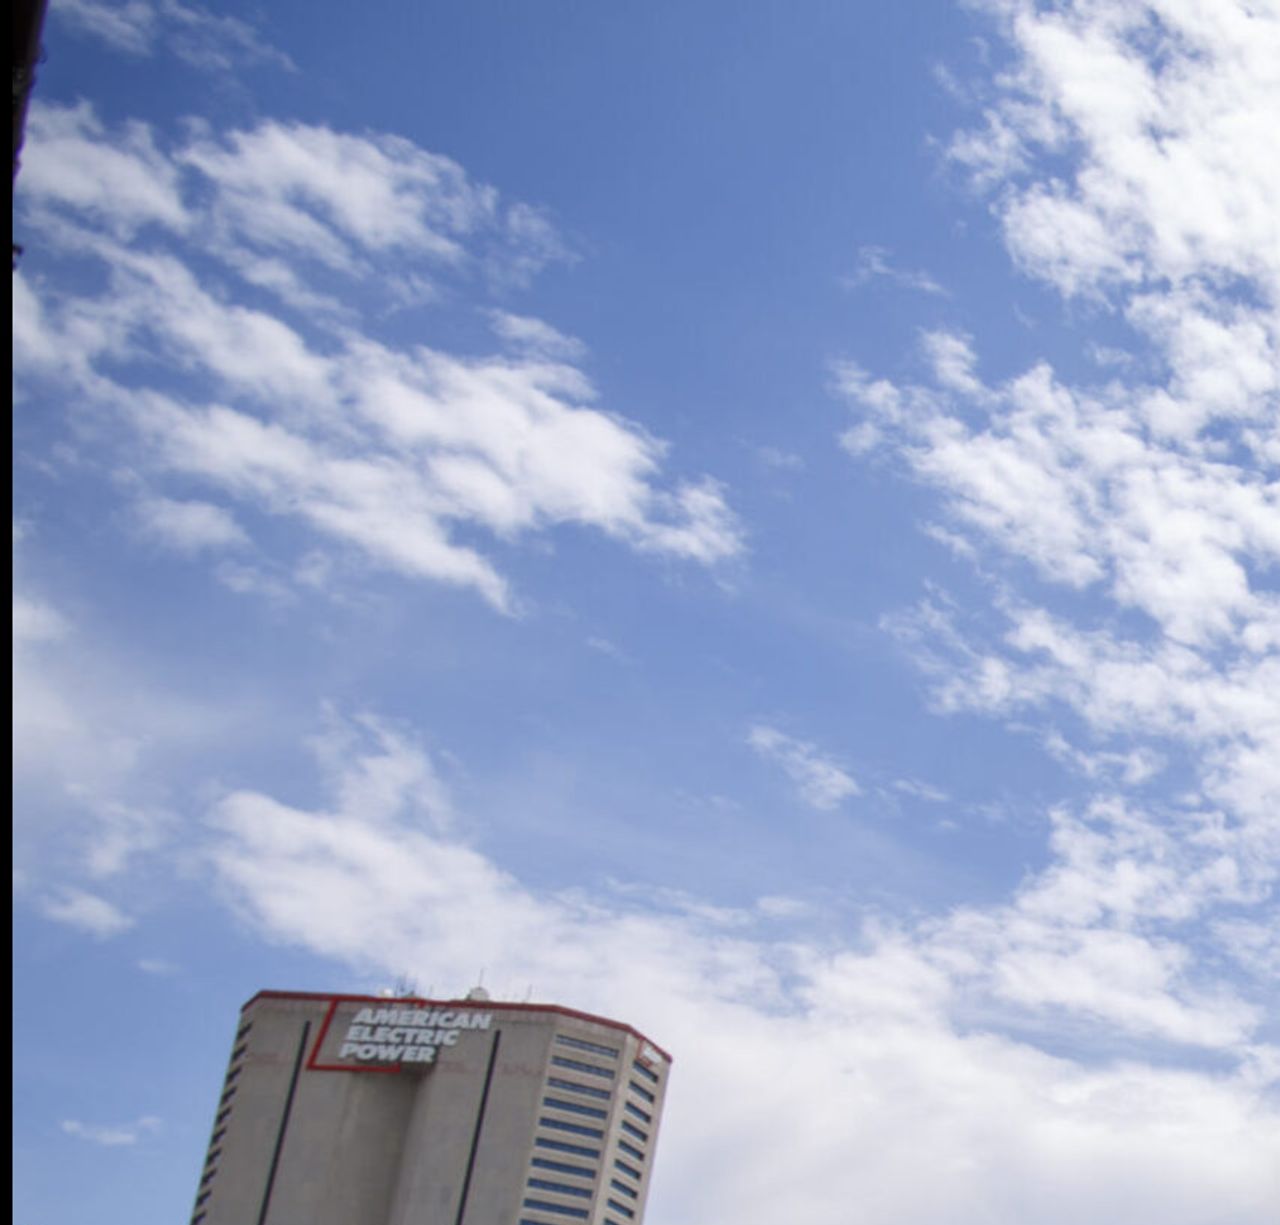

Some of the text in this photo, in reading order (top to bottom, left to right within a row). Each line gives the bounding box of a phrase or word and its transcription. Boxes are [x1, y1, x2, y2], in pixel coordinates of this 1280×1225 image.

[352, 1008, 491, 1030] AMERICAN
[346, 1026, 459, 1046] ELECTRIC
[339, 1043, 436, 1063] POWER
